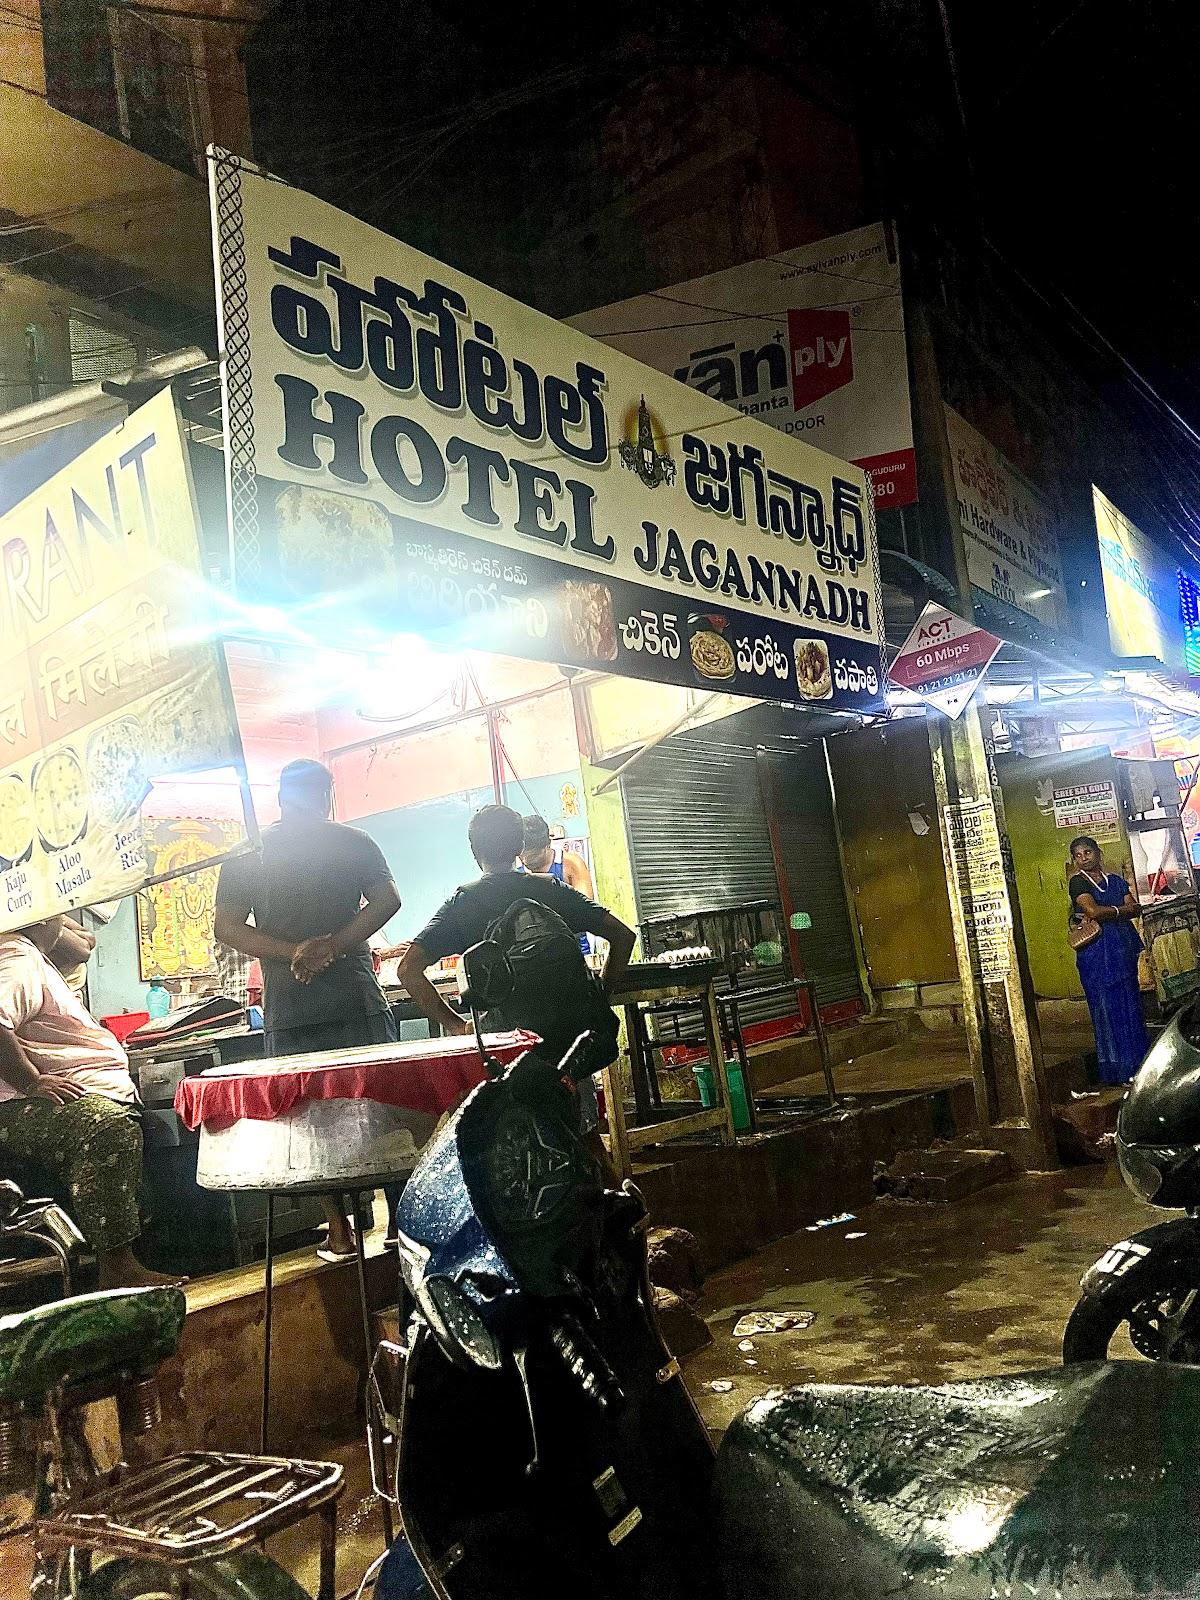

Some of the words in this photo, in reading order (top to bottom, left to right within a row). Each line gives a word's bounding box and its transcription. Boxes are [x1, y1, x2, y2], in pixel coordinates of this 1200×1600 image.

[795, 337, 847, 376] ply
[785, 414, 825, 434] DOOR
[275, 374, 615, 561] HOTEL
[633, 521, 872, 633] JAGANNADH
[970, 503, 1018, 555] Hardware
[618, 610, 681, 660] చికెన్
[918, 617, 953, 642] ACT
[916, 653, 933, 668] 60
[934, 643, 970, 662] Mbps
[834, 658, 879, 695] చపాతి
[918, 684, 929, 694] 91
[931, 680, 941, 691] 21
[943, 676, 953, 686] 21
[955, 672, 966, 682] 21
[967, 667, 978, 678] 21
[59, 851, 82, 875] Aloo
[5, 871, 27, 893] Kaju
[56, 868, 92, 897] Masala
[7, 890, 33, 913] Curry
